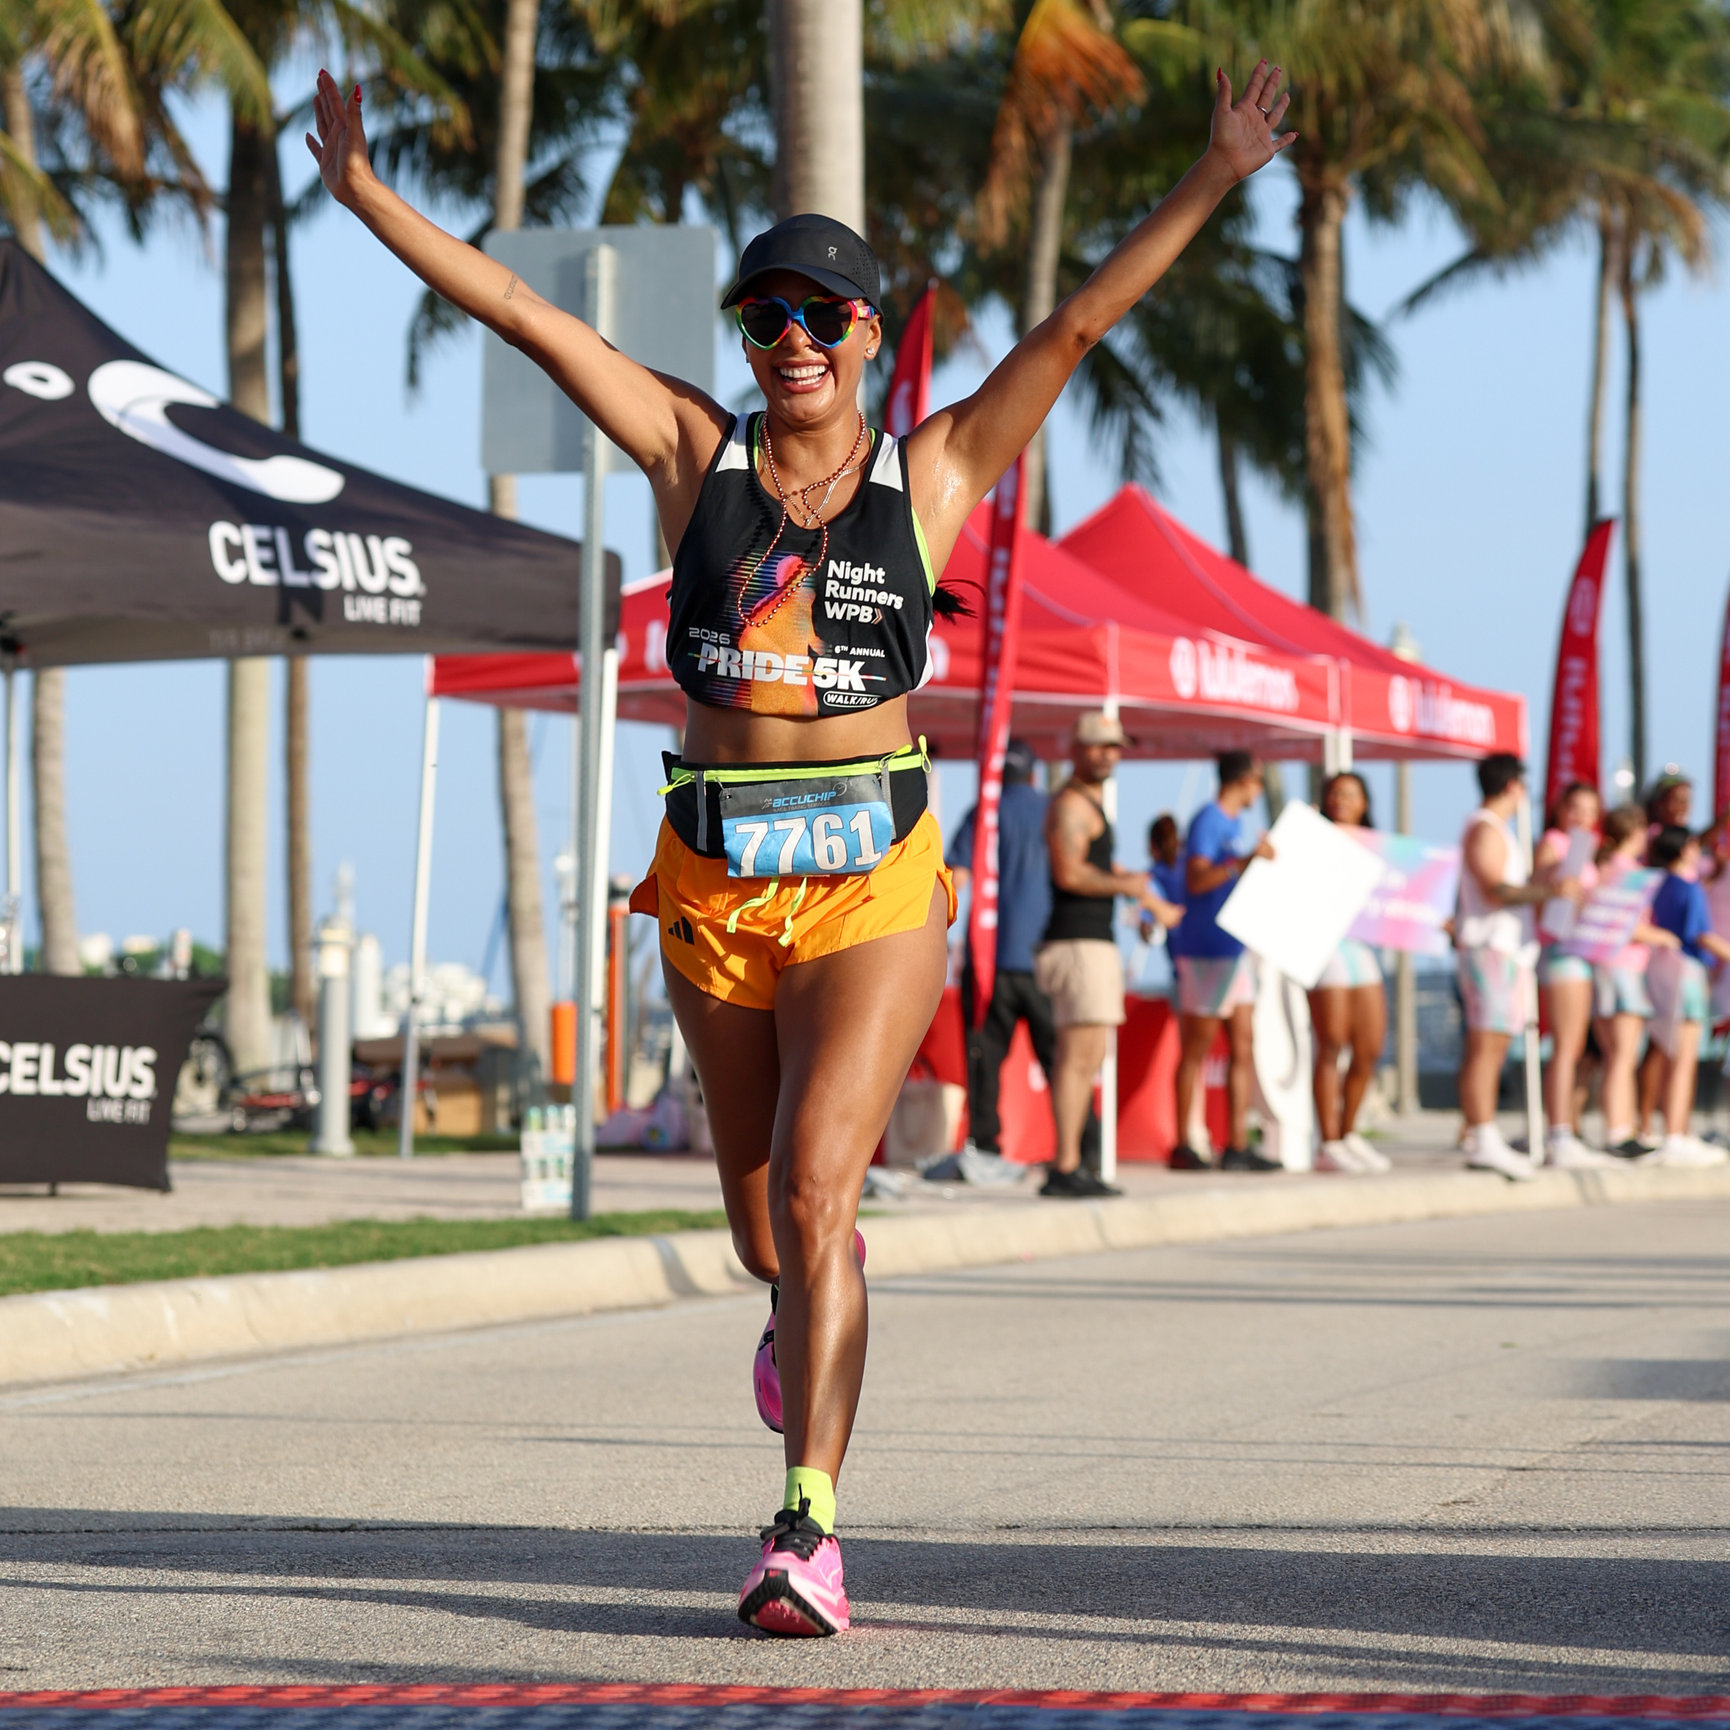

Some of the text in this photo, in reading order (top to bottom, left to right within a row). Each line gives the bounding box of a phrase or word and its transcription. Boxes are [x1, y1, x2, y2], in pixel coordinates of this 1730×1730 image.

[208, 520, 422, 597] CELSIUS
[827, 560, 886, 585] Night
[825, 579, 904, 610] Runners
[344, 594, 422, 627] LIVE FIT
[688, 627, 731, 645] 2026
[834, 645, 886, 658] 6TH ANNUAL
[697, 642, 810, 686] PRIDE
[812, 657, 867, 692] 5K
[736, 810, 882, 877] 7761
[87, 1097, 124, 1123] LIVE
